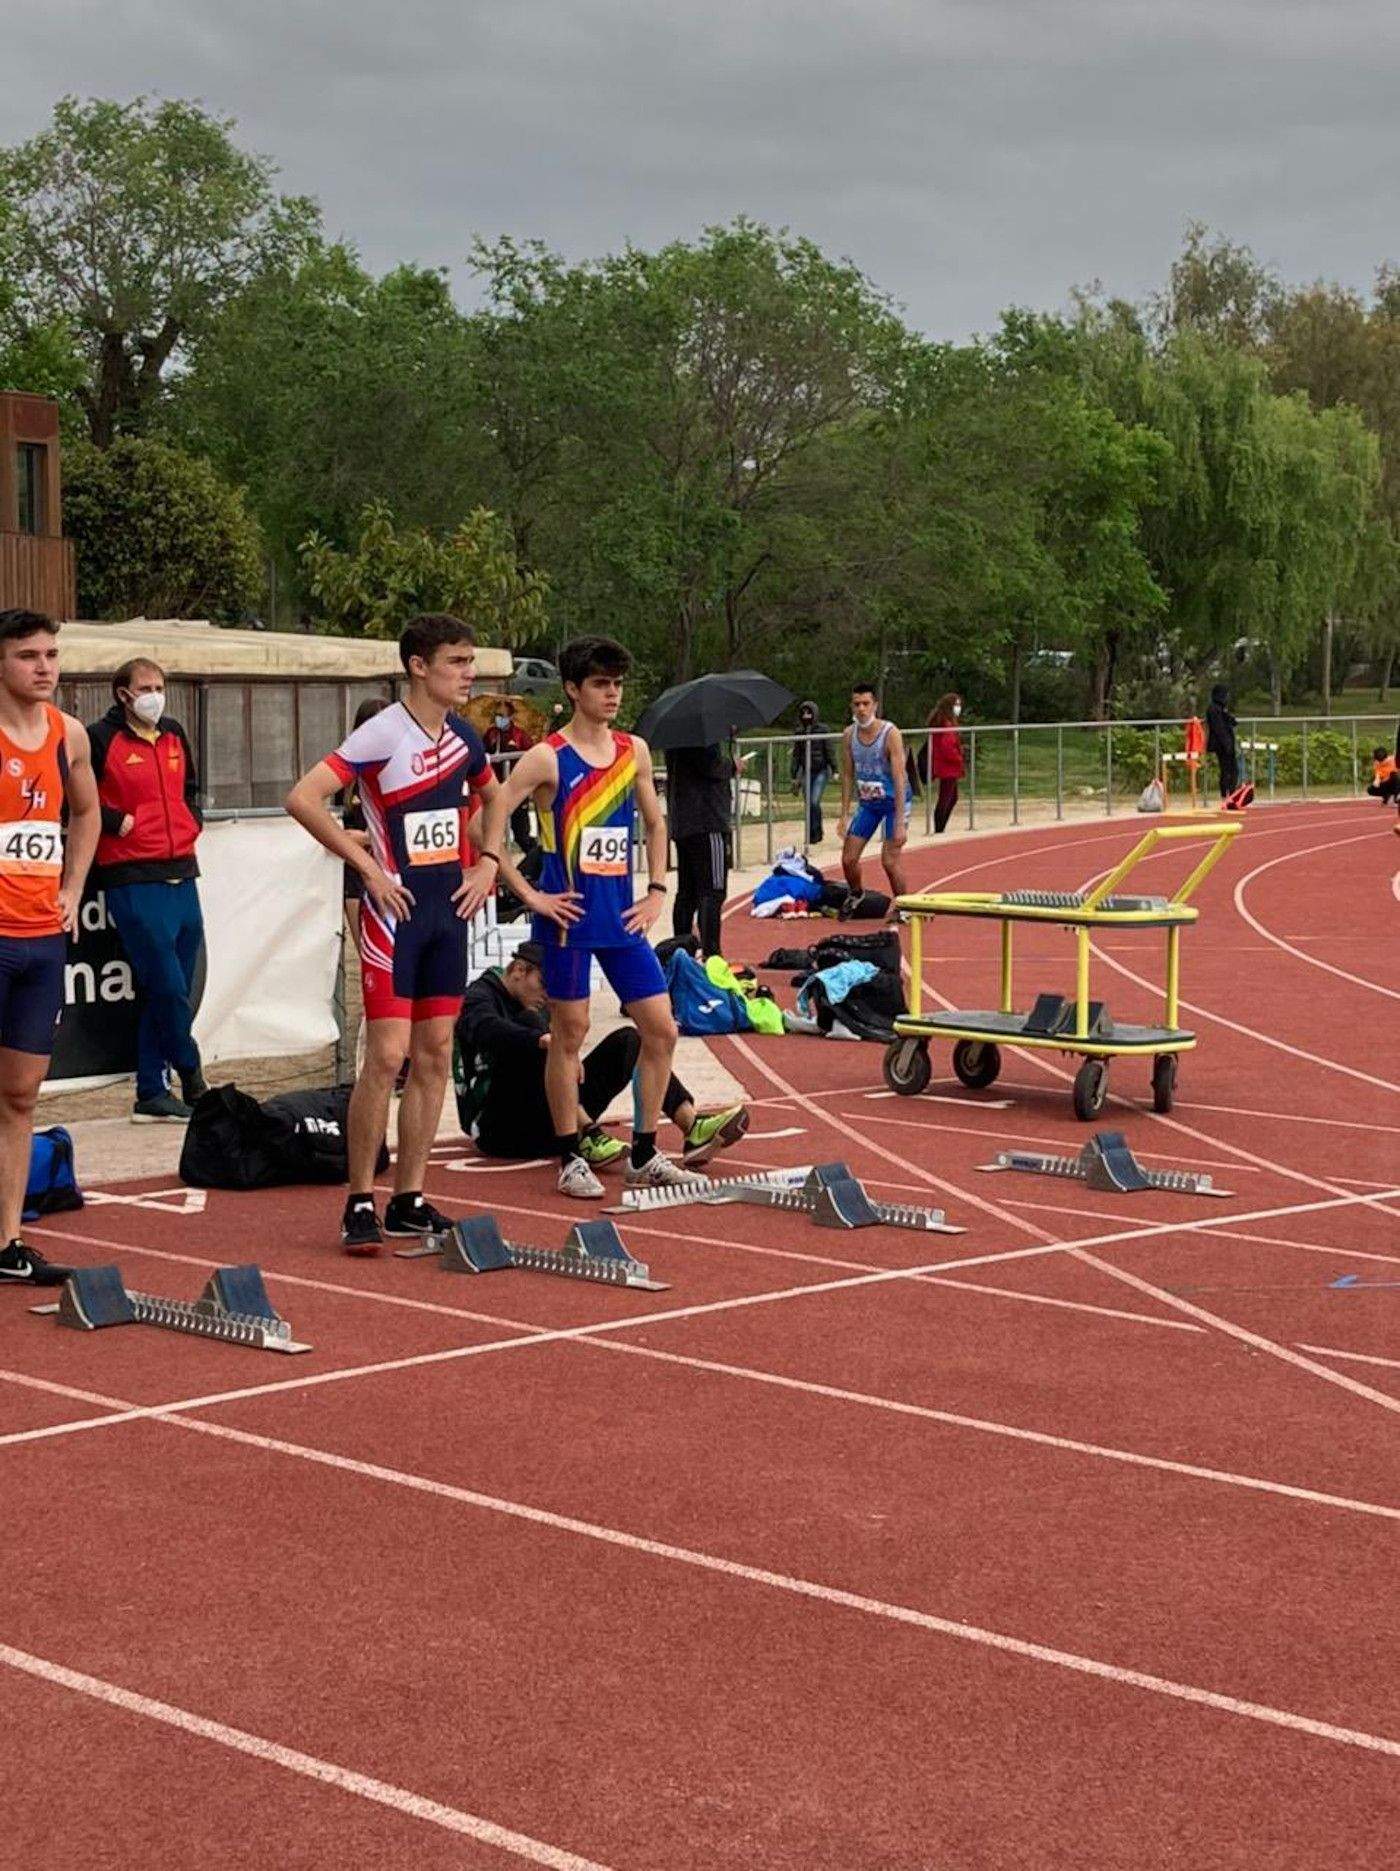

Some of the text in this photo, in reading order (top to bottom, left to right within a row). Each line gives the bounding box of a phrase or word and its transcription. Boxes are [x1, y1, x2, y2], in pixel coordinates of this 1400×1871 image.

[6, 832, 56, 860] 467
[413, 820, 455, 850] 465
[587, 837, 627, 862] 499
